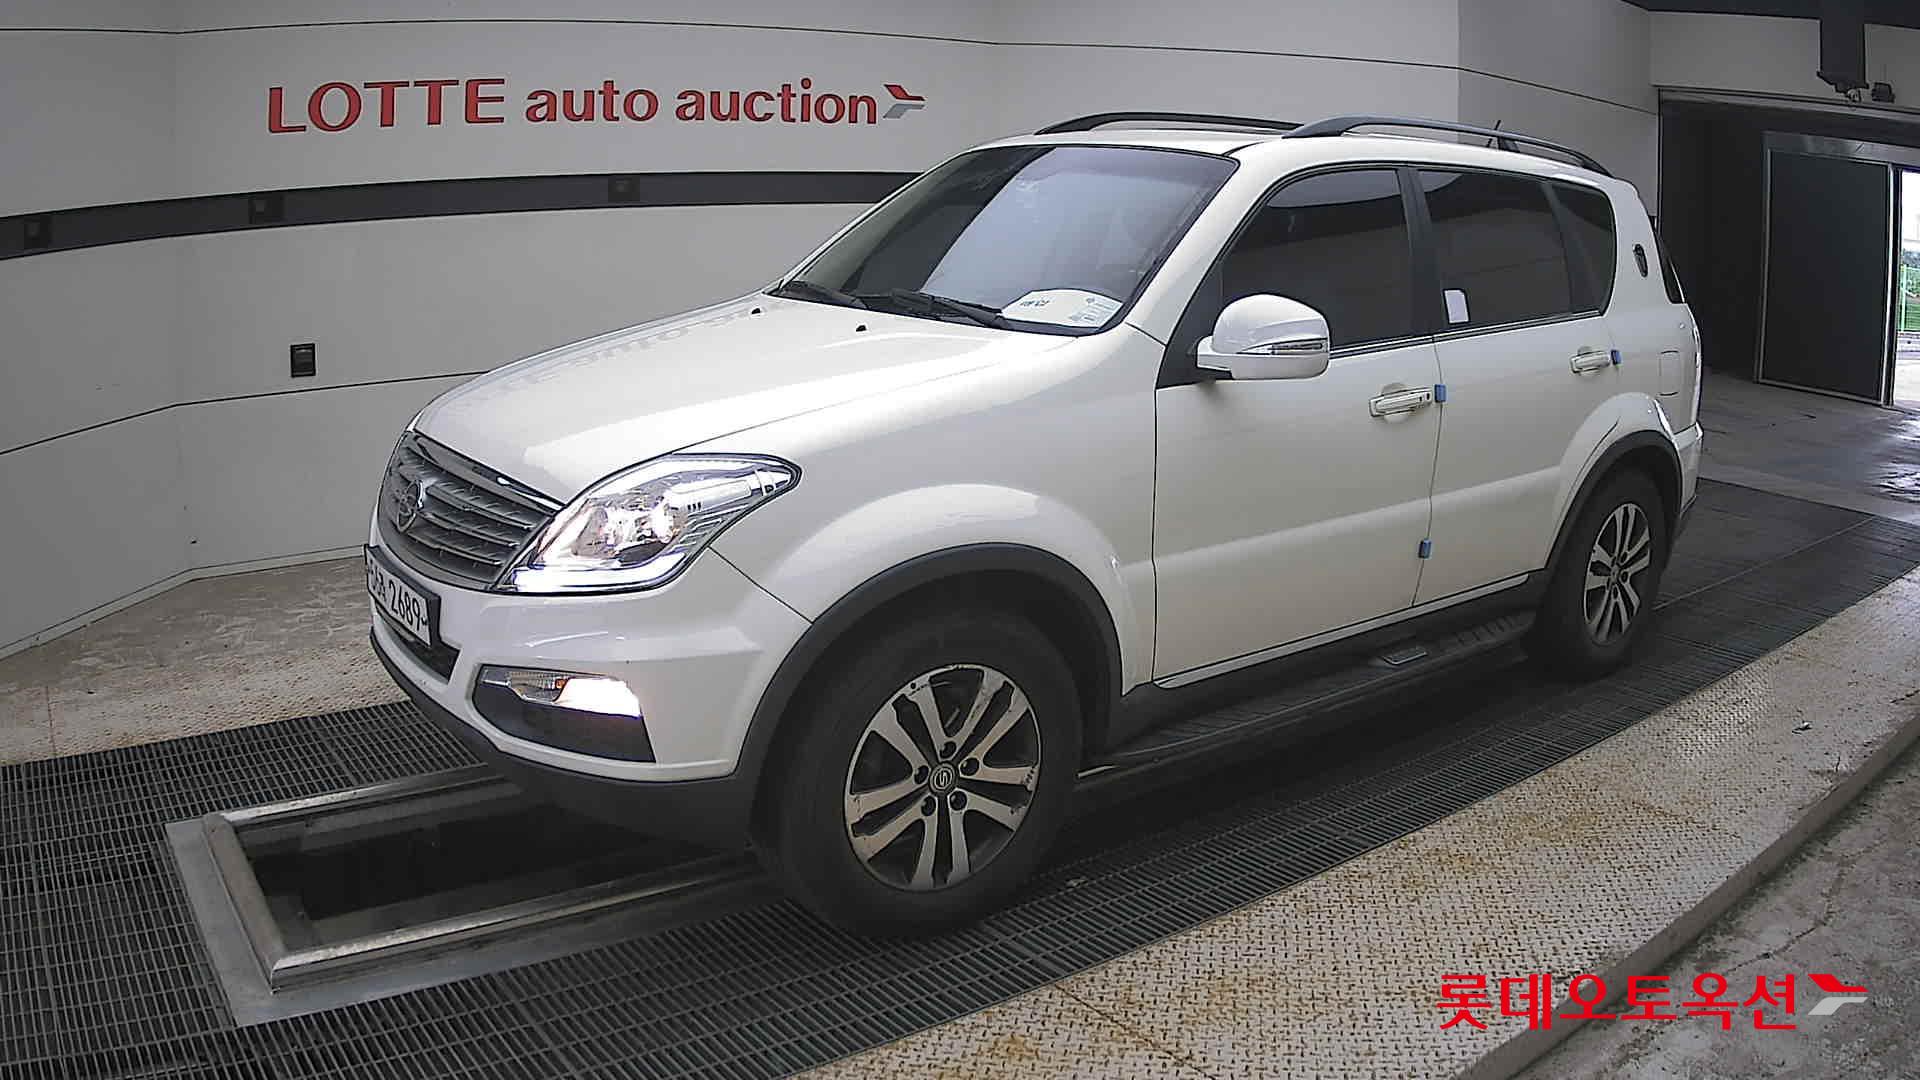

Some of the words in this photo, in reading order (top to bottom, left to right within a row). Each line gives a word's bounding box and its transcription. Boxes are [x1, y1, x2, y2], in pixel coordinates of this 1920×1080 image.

[267, 78, 505, 133] LOTTE
[525, 80, 659, 122] auto
[675, 78, 878, 125] auction
